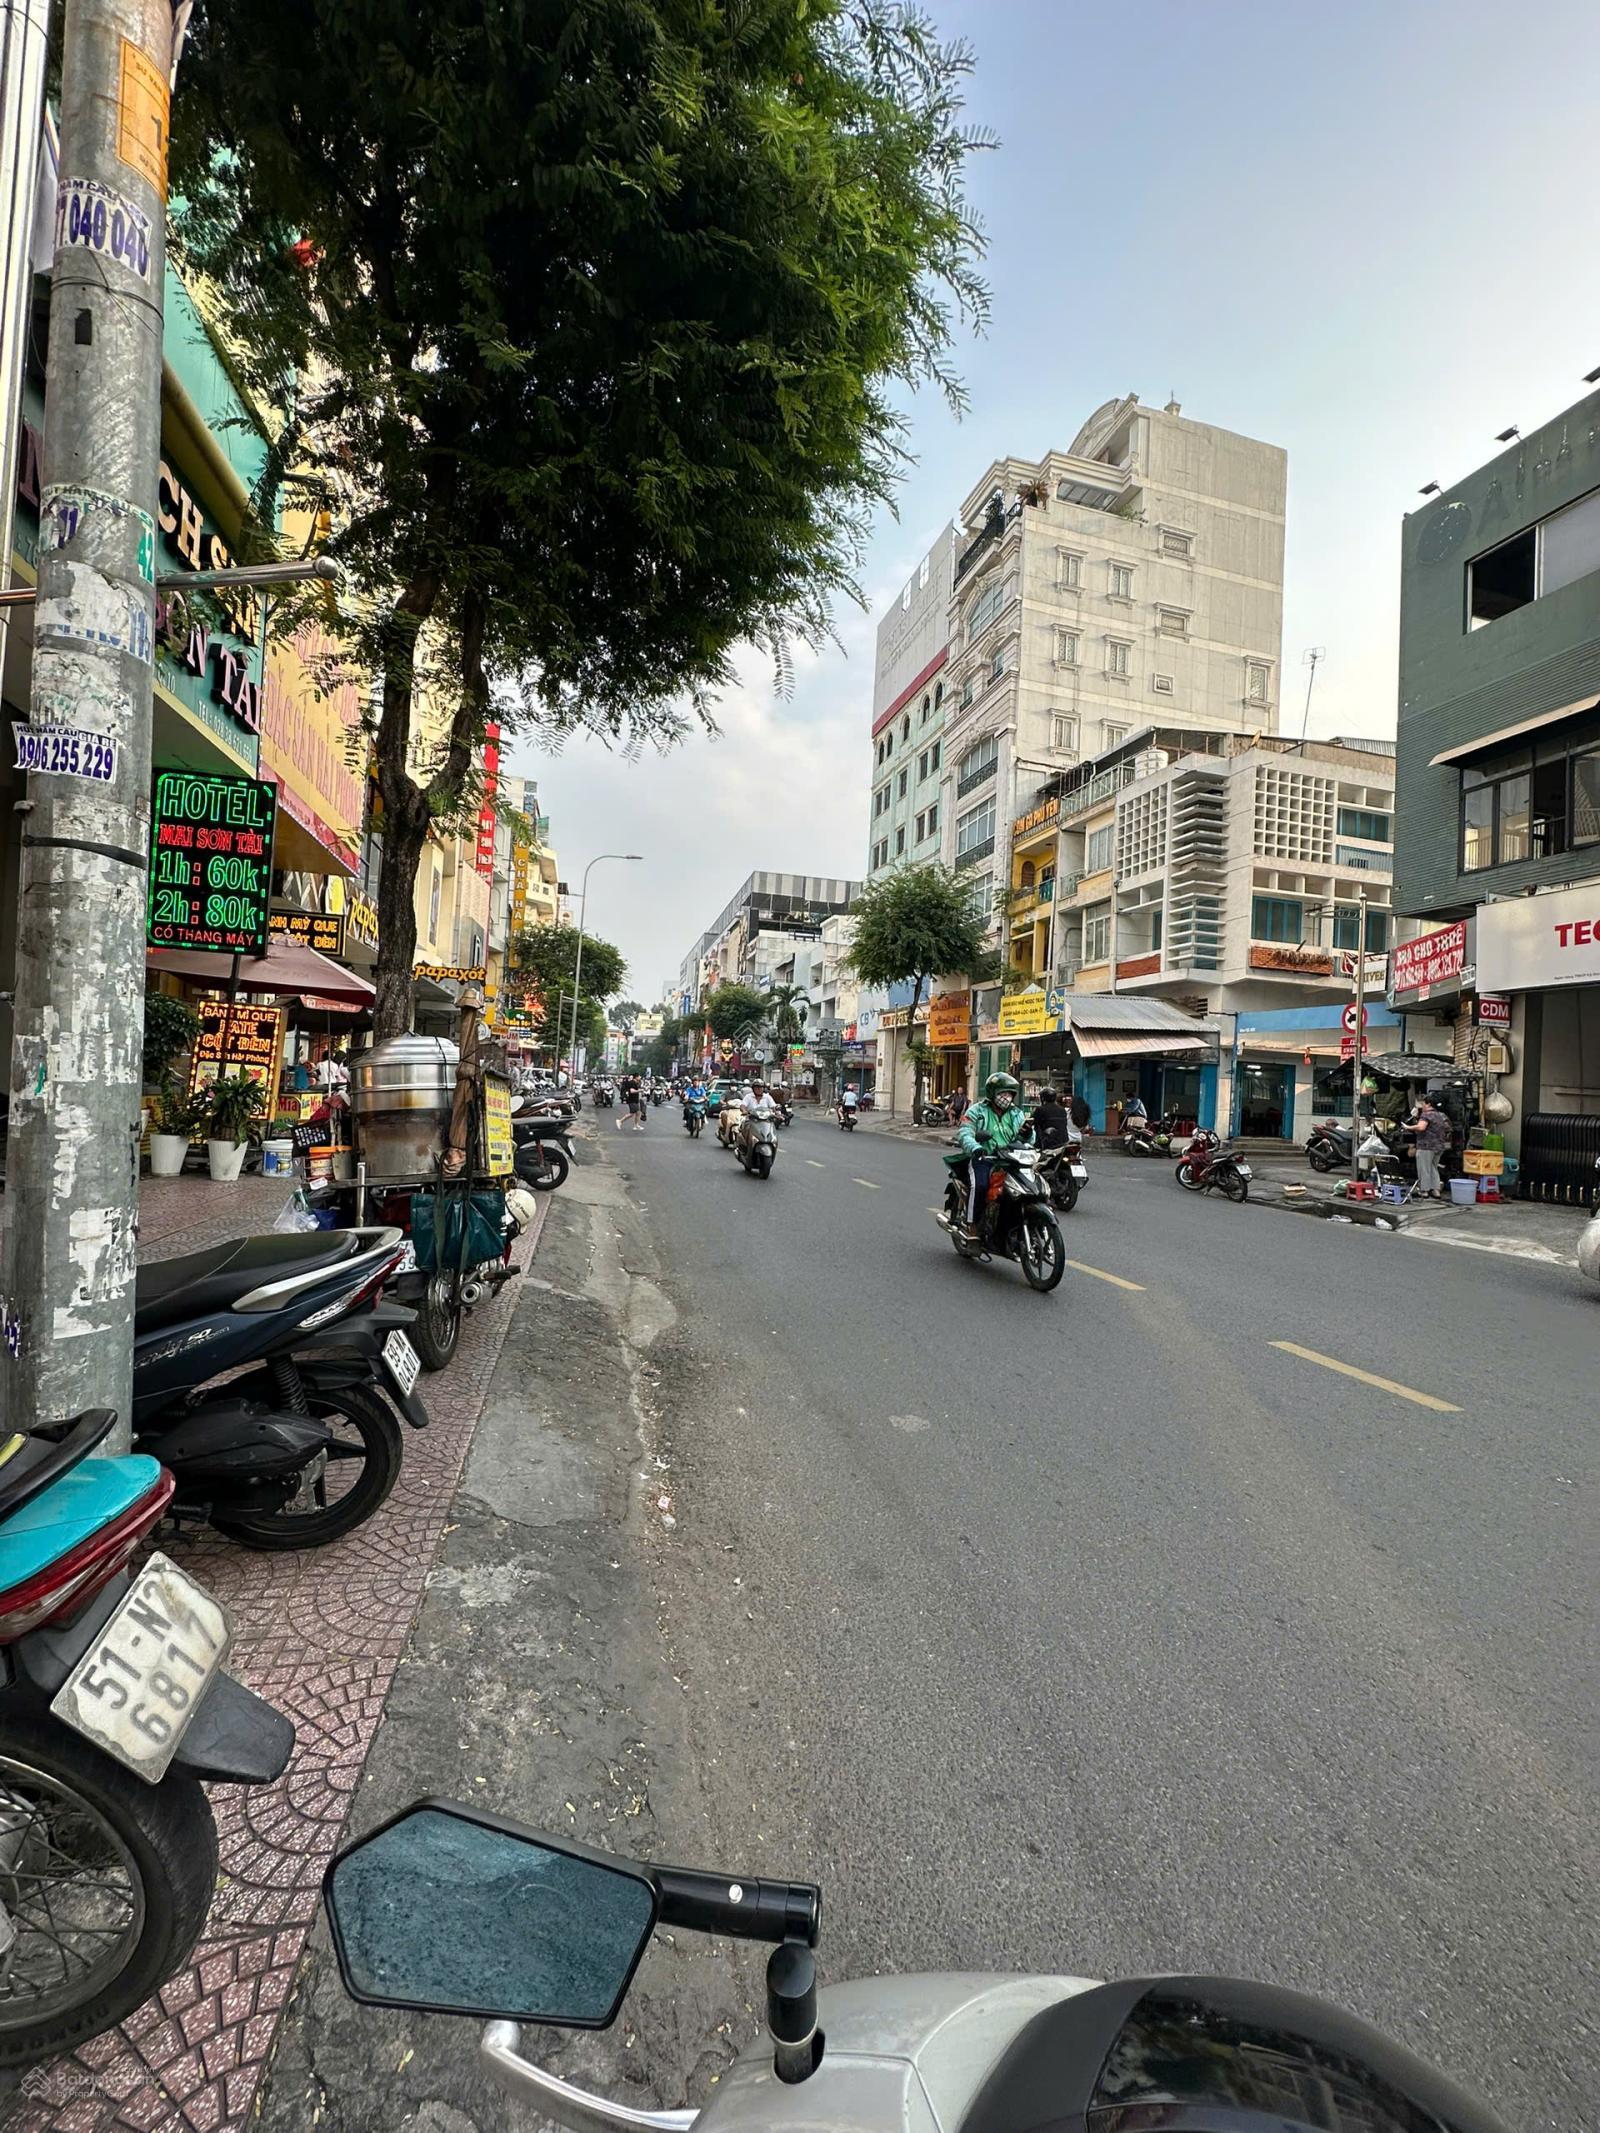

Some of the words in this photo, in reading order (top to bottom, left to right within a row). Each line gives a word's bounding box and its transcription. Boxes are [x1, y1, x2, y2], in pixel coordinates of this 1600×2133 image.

[162, 778, 265, 827] HOTEL
[158, 823, 194, 847] MAI
[196, 827, 233, 852] SƠN
[235, 829, 264, 855] TÀI
[207, 855, 259, 892] 60k
[205, 894, 258, 931] 80k
[314, 920, 338, 933] QUE
[153, 925, 175, 938] CÓ
[177, 928, 223, 944] THANG
[251, 1013, 275, 1022] QUE
[1480, 1002, 1509, 1018] CDM
[129, 1609, 217, 1745] 6817
